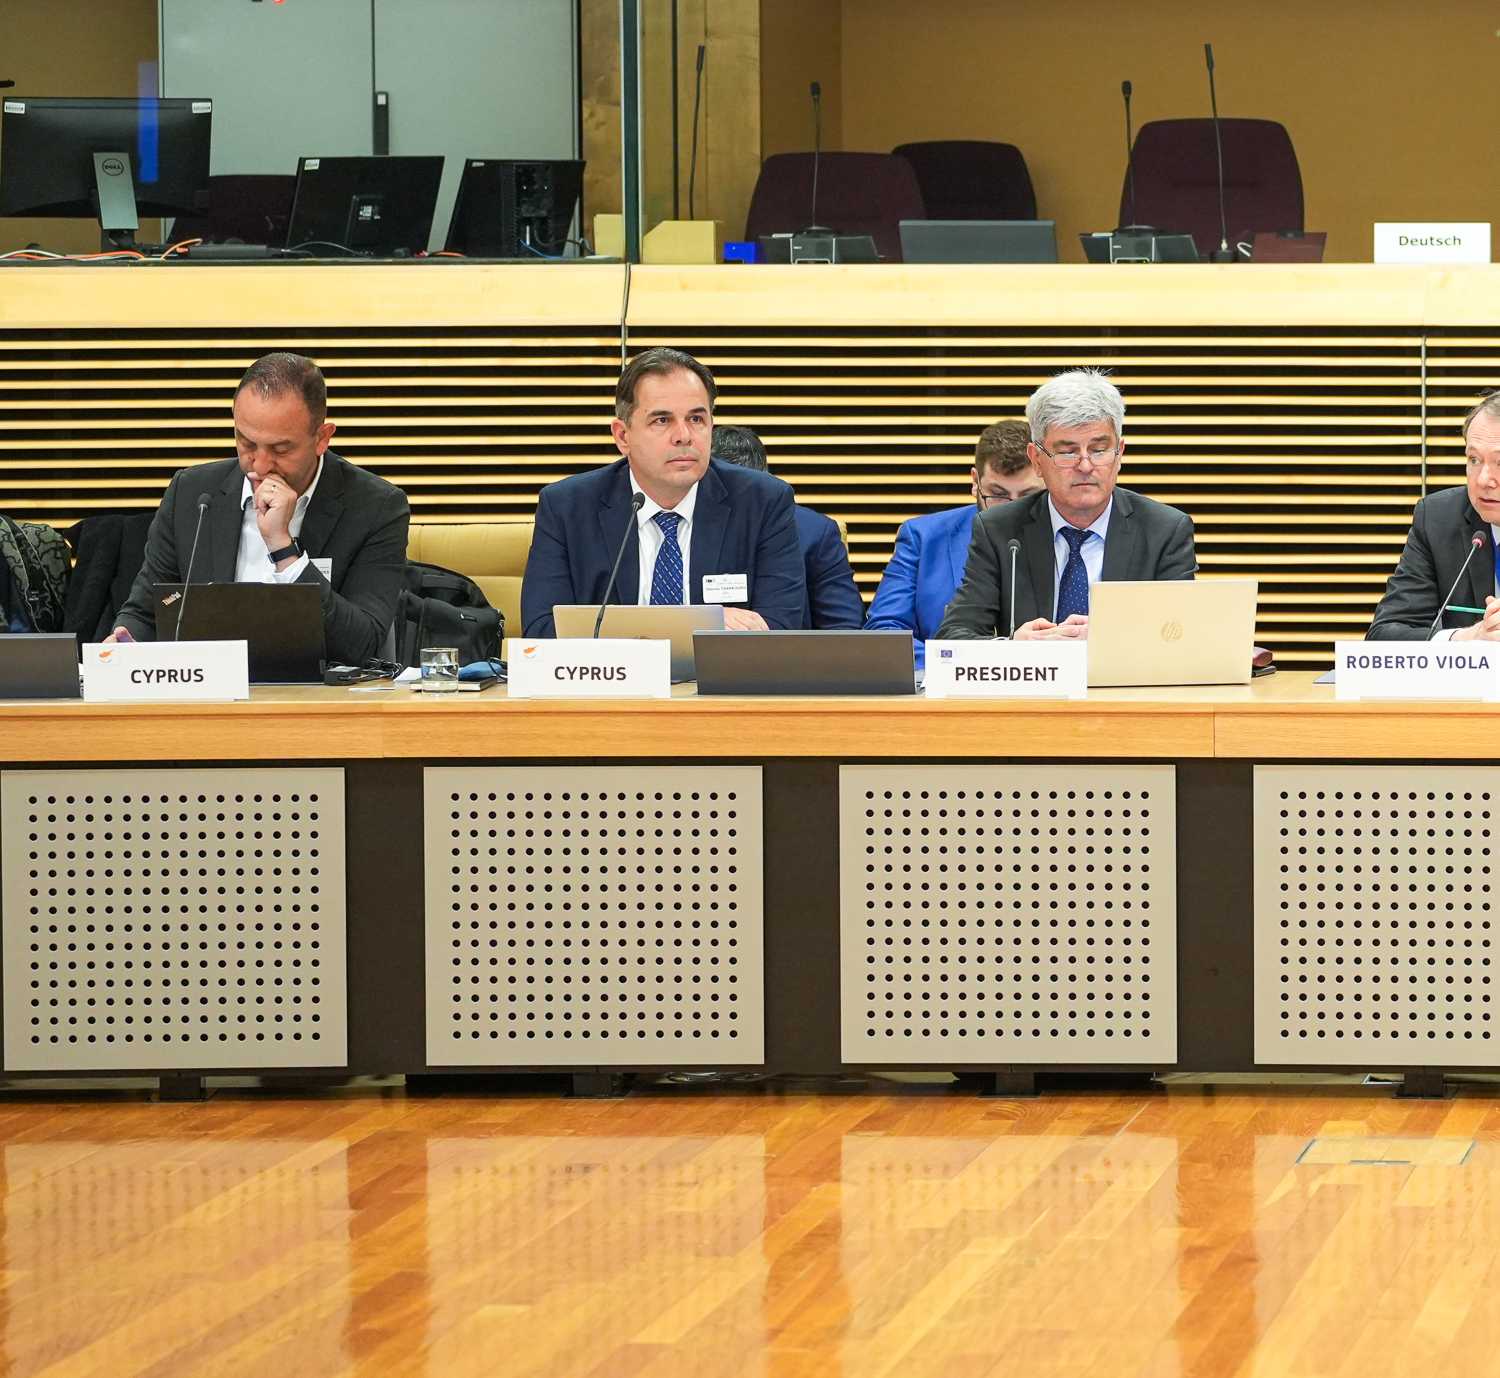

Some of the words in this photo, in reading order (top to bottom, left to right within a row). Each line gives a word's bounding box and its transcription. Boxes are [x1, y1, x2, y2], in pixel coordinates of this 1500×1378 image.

[1399, 236, 1461, 246] Deutsch
[161, 591, 181, 606] ThinkPad
[1346, 655, 1428, 670] ROBERTO
[1435, 655, 1490, 669] VIOLA
[130, 668, 204, 684] CYPRUS
[554, 666, 627, 682] CYPRUS
[955, 666, 1059, 682] PRESIDENT
